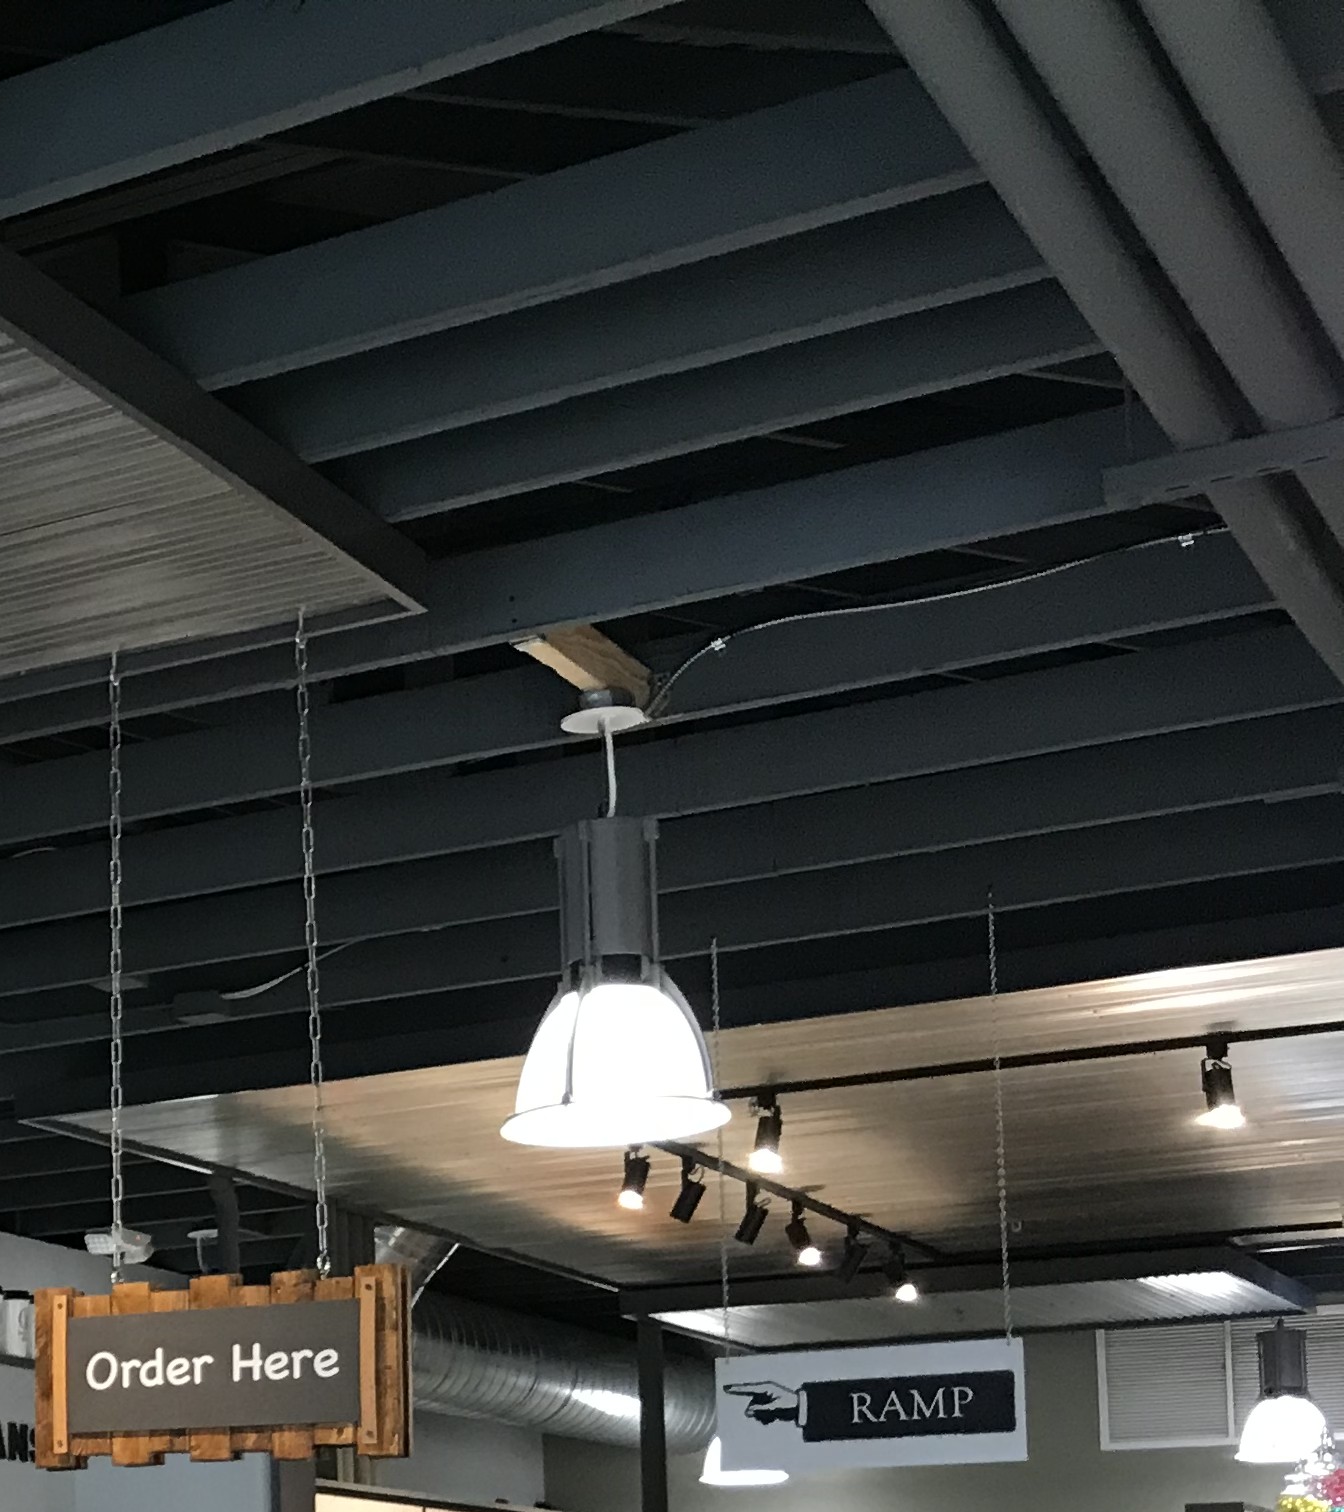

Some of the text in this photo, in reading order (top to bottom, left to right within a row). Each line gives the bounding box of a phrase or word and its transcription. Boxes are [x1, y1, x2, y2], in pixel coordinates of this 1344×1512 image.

[86, 1342, 339, 1391] Order Here
[850, 1386, 974, 1424] RAMP
